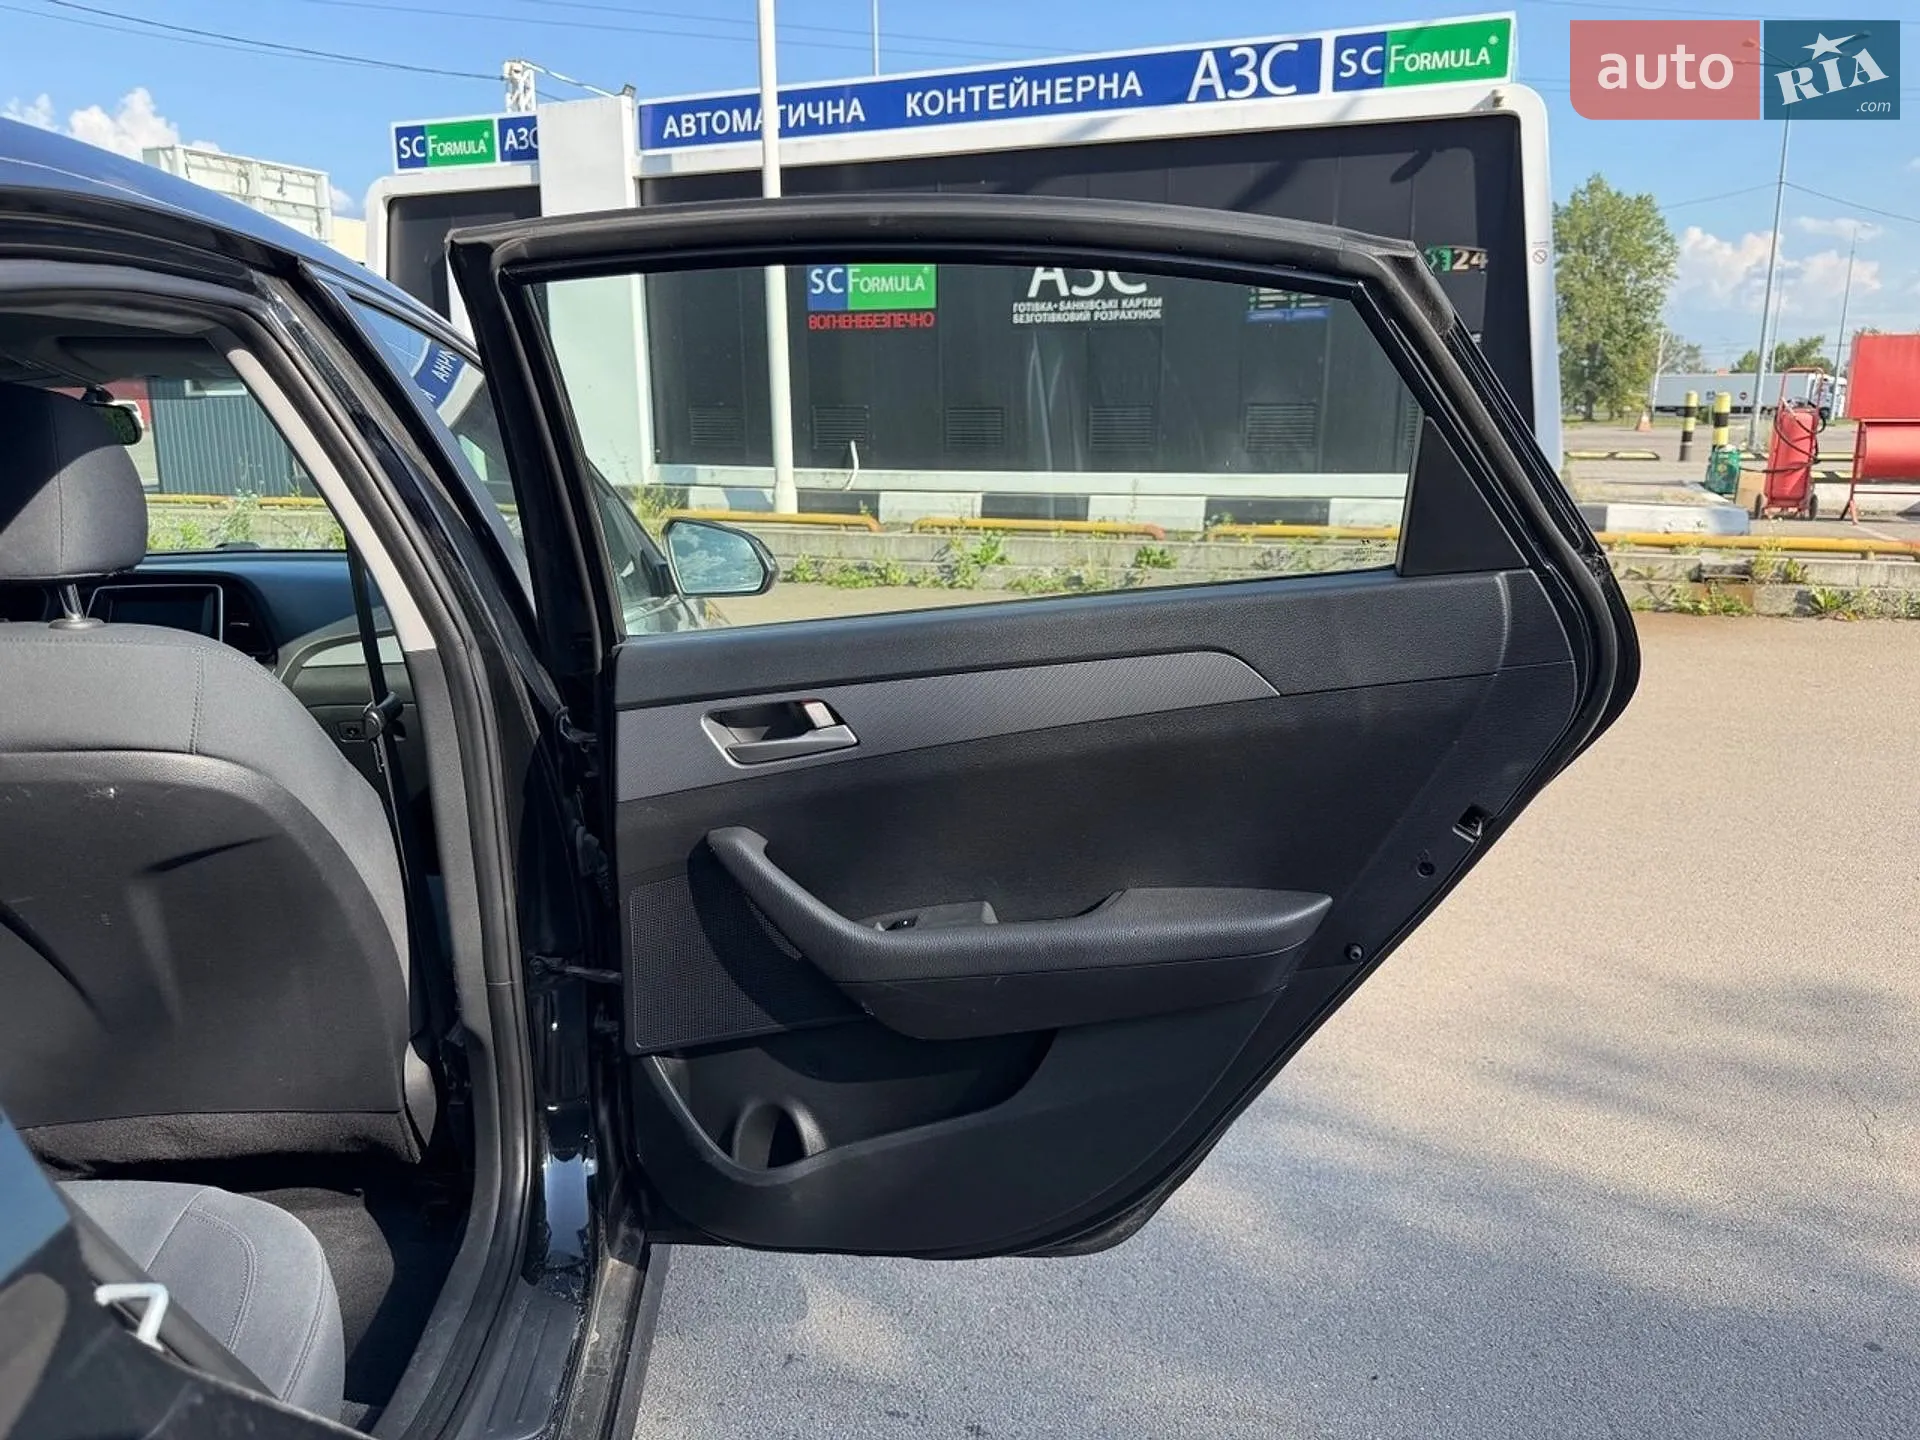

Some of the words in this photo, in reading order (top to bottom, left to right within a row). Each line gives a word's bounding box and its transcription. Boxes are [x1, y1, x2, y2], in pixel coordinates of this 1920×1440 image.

[1339, 46, 1384, 78] SC
[906, 70, 1144, 118] КОНТЕЙНЕРНА
[399, 136, 425, 158] SC
[810, 267, 844, 294] SC
